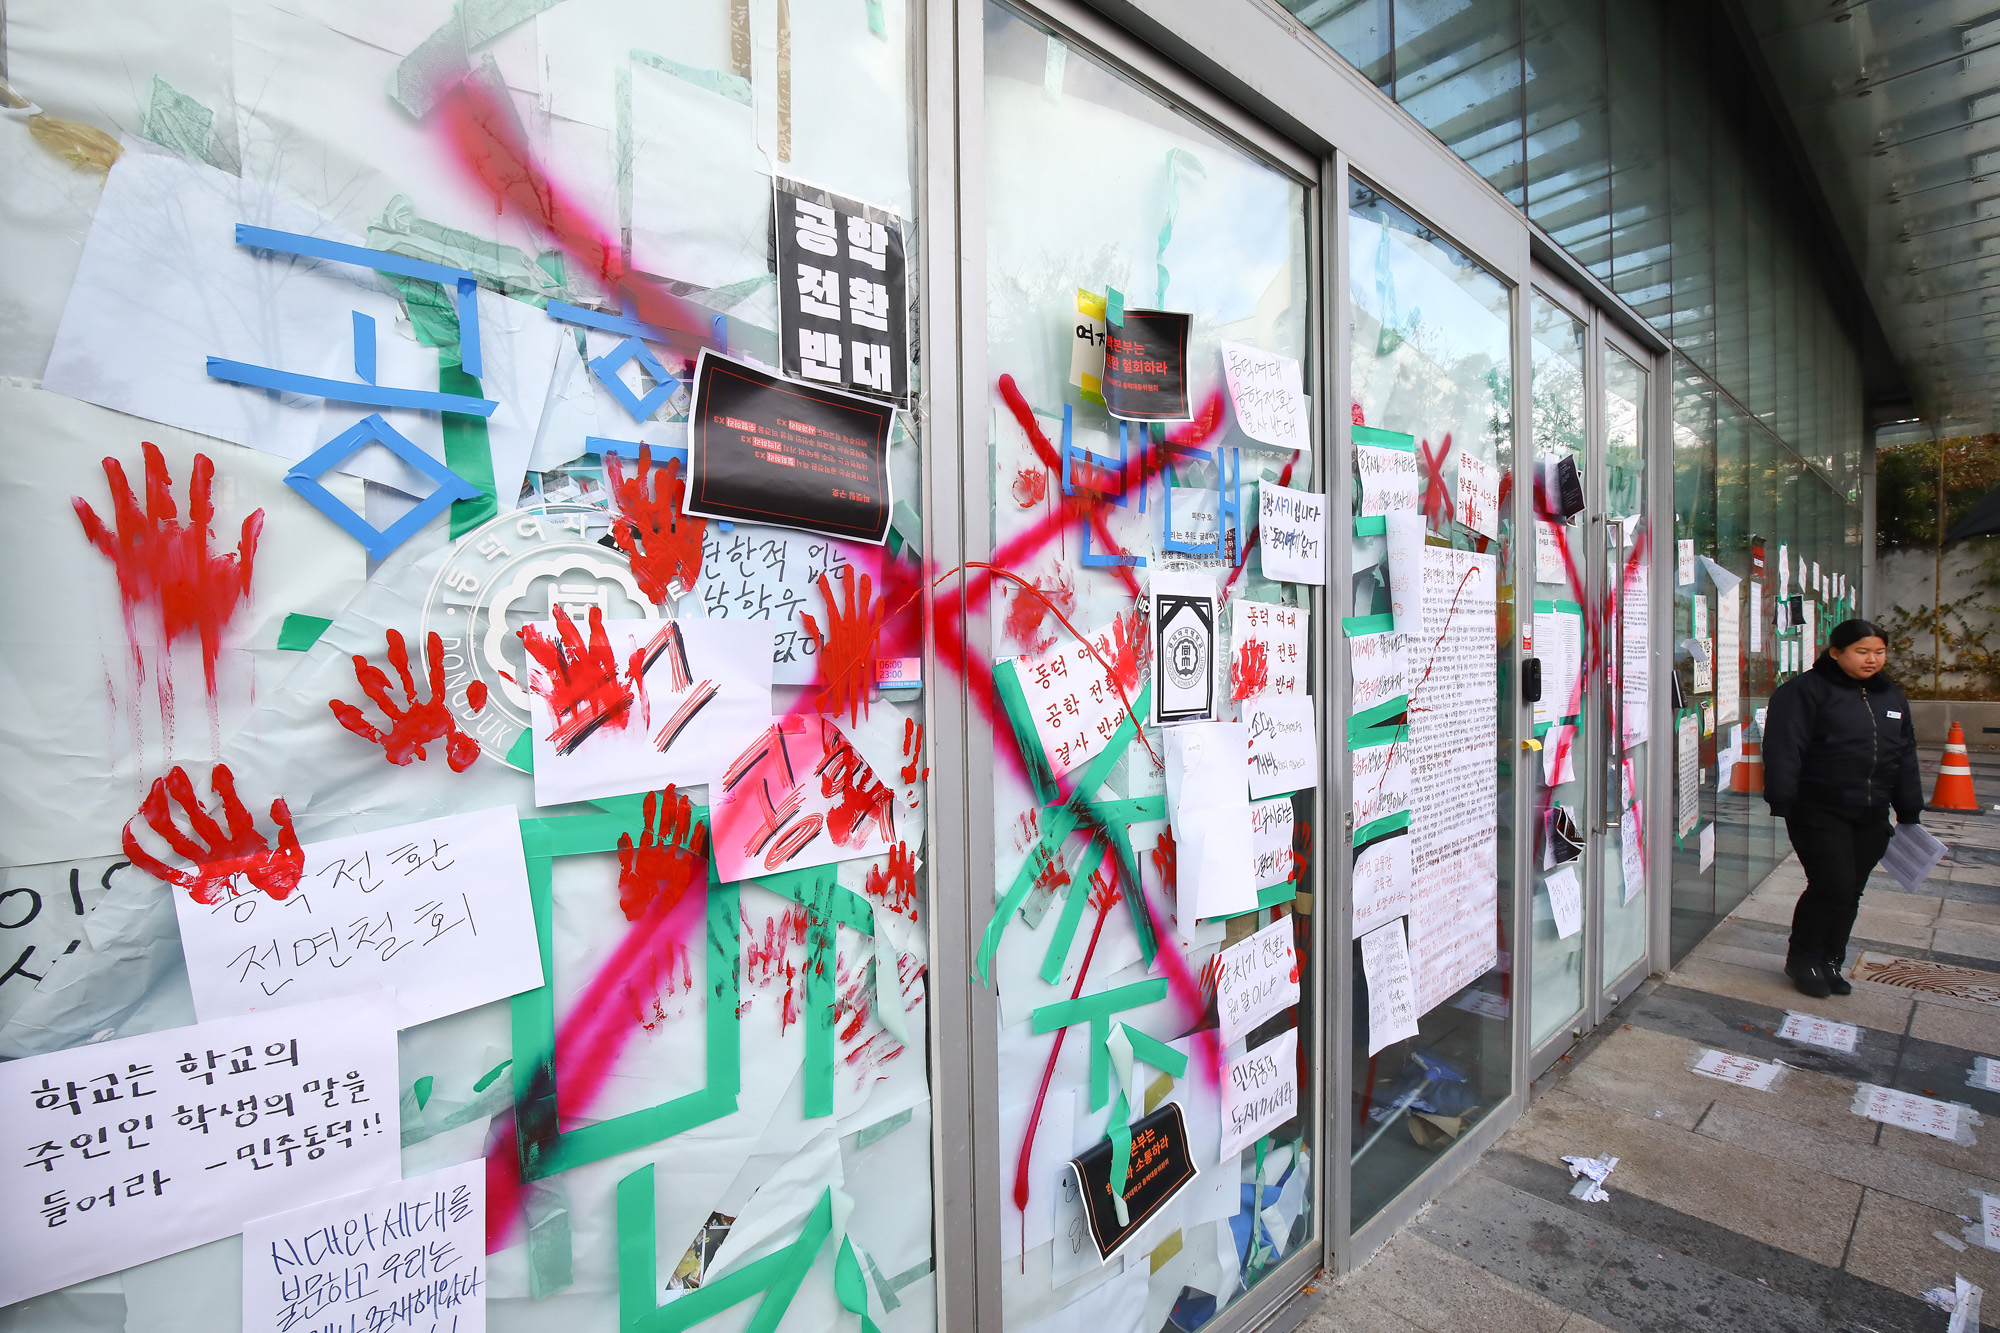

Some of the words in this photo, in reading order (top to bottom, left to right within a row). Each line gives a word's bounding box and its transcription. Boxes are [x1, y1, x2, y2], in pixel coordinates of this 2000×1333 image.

[796, 197, 888, 271] 공학
[797, 263, 889, 332] 전환
[799, 328, 892, 393] 반대
[1106, 335, 1145, 356] 학본부는
[1122, 359, 1168, 376] 철회하라
[1228, 350, 1282, 381] 동덕여대
[753, 437, 781, 450] 기억하라
[767, 453, 795, 466] 철회하라
[831, 488, 847, 498] 구호
[849, 492, 870, 503] 피켓팅
[1246, 606, 1269, 629] 동덕
[1276, 610, 1296, 630] 여대
[880, 661, 902, 669] 06:00
[1035, 655, 1068, 689] 동덕
[1078, 633, 1111, 663] 여대
[1276, 642, 1297, 663] 전환
[441, 636, 513, 748] DONGDUK
[880, 670, 902, 679] 23:00
[1275, 674, 1296, 694] 반대
[1046, 694, 1080, 728] 공학
[1089, 679, 1119, 705] 전환
[1055, 732, 1089, 766] 결사
[1096, 707, 1126, 741] 반대
[316, 838, 455, 893] 전환
[1262, 934, 1285, 969] 전환
[30, 1063, 157, 1115] 학교는
[176, 1038, 299, 1086] 학교의
[1232, 1054, 1278, 1092] 민주동덕
[24, 1114, 154, 1172] 주인인
[171, 1093, 295, 1134] 학생의
[303, 1070, 371, 1108] 말을
[1131, 1128, 1156, 1158] 본부는
[1136, 1134, 1169, 1173] 소통하라
[40, 1169, 171, 1228] 들어라
[382, 1184, 473, 1247] 세대를
[276, 1262, 380, 1333] 불문하고
[377, 1240, 463, 1284] 우리는
